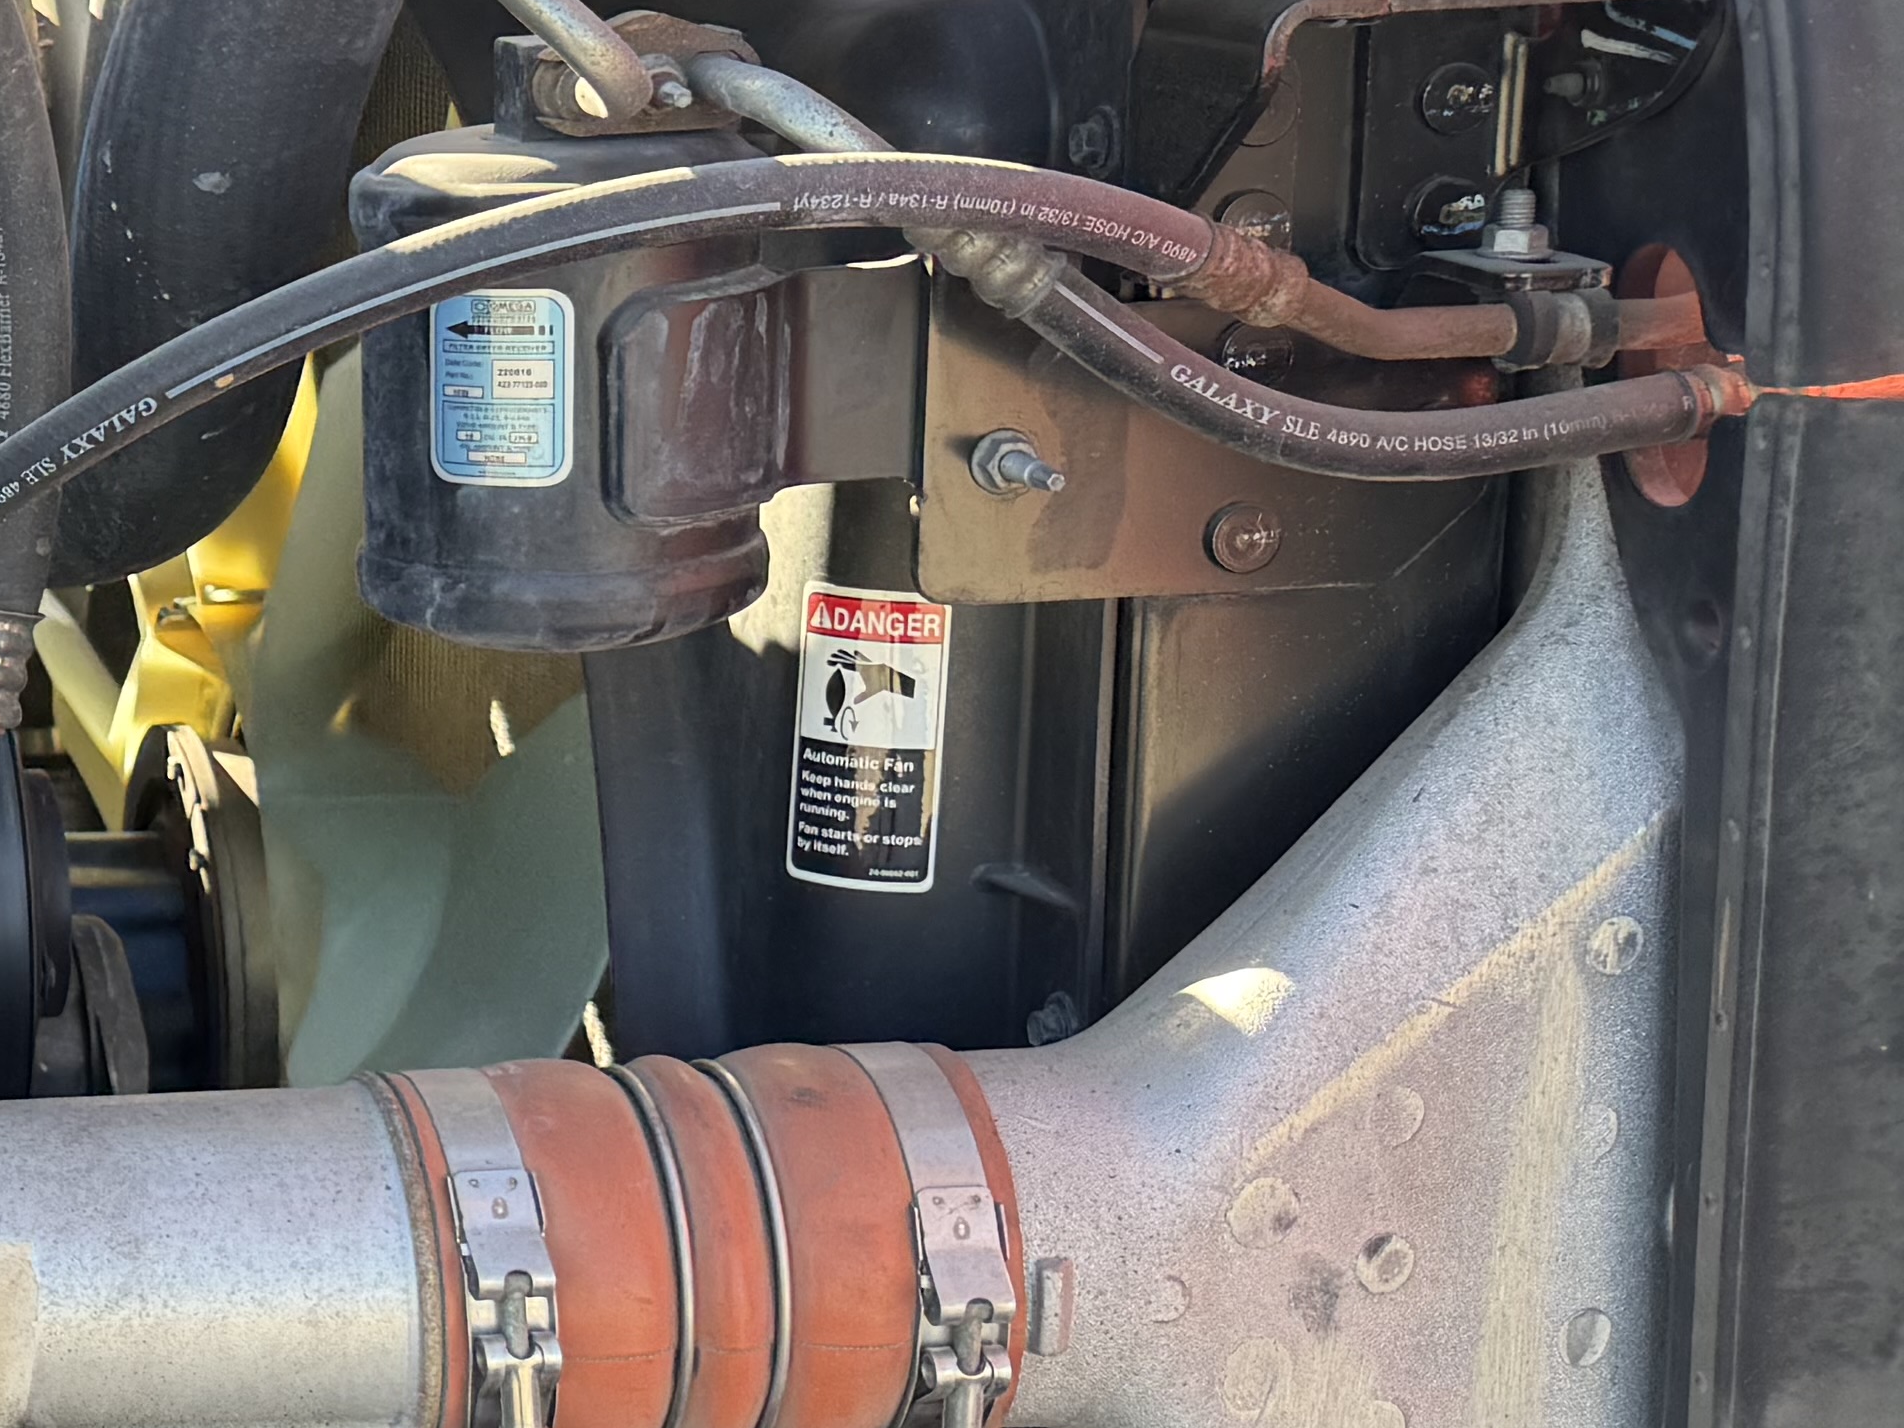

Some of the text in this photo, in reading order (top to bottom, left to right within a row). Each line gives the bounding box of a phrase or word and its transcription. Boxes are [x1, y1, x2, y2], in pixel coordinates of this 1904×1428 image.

[793, 192, 872, 213] R-1234yf
[889, 192, 947, 210] R-134a
[954, 196, 1017, 216] (10mm)
[1020, 201, 1036, 216] in
[1039, 205, 1081, 231] 13/32
[1082, 216, 1129, 246] HOSE
[1129, 227, 1160, 250] A/C
[1161, 236, 1198, 263] 4890
[1170, 363, 1282, 426] GALAXY
[1282, 415, 1321, 441] SLE
[1326, 429, 1370, 451] 4890
[1376, 433, 1409, 453] A/C
[1414, 433, 1467, 453] HOSE
[1472, 429, 1519, 451] 13/32
[1543, 412, 1607, 442] (10mm)
[60, 396, 158, 466] GALAXY
[20, 456, 58, 486] SLE
[833, 607, 940, 638] DANGER
[803, 747, 914, 772] Automatic Fan
[802, 770, 915, 794] Keep hands clear
[800, 786, 897, 808] when engine is
[800, 802, 849, 821] running.
[797, 836, 849, 857] by itself.
[799, 821, 922, 848] Fan starts or stops
